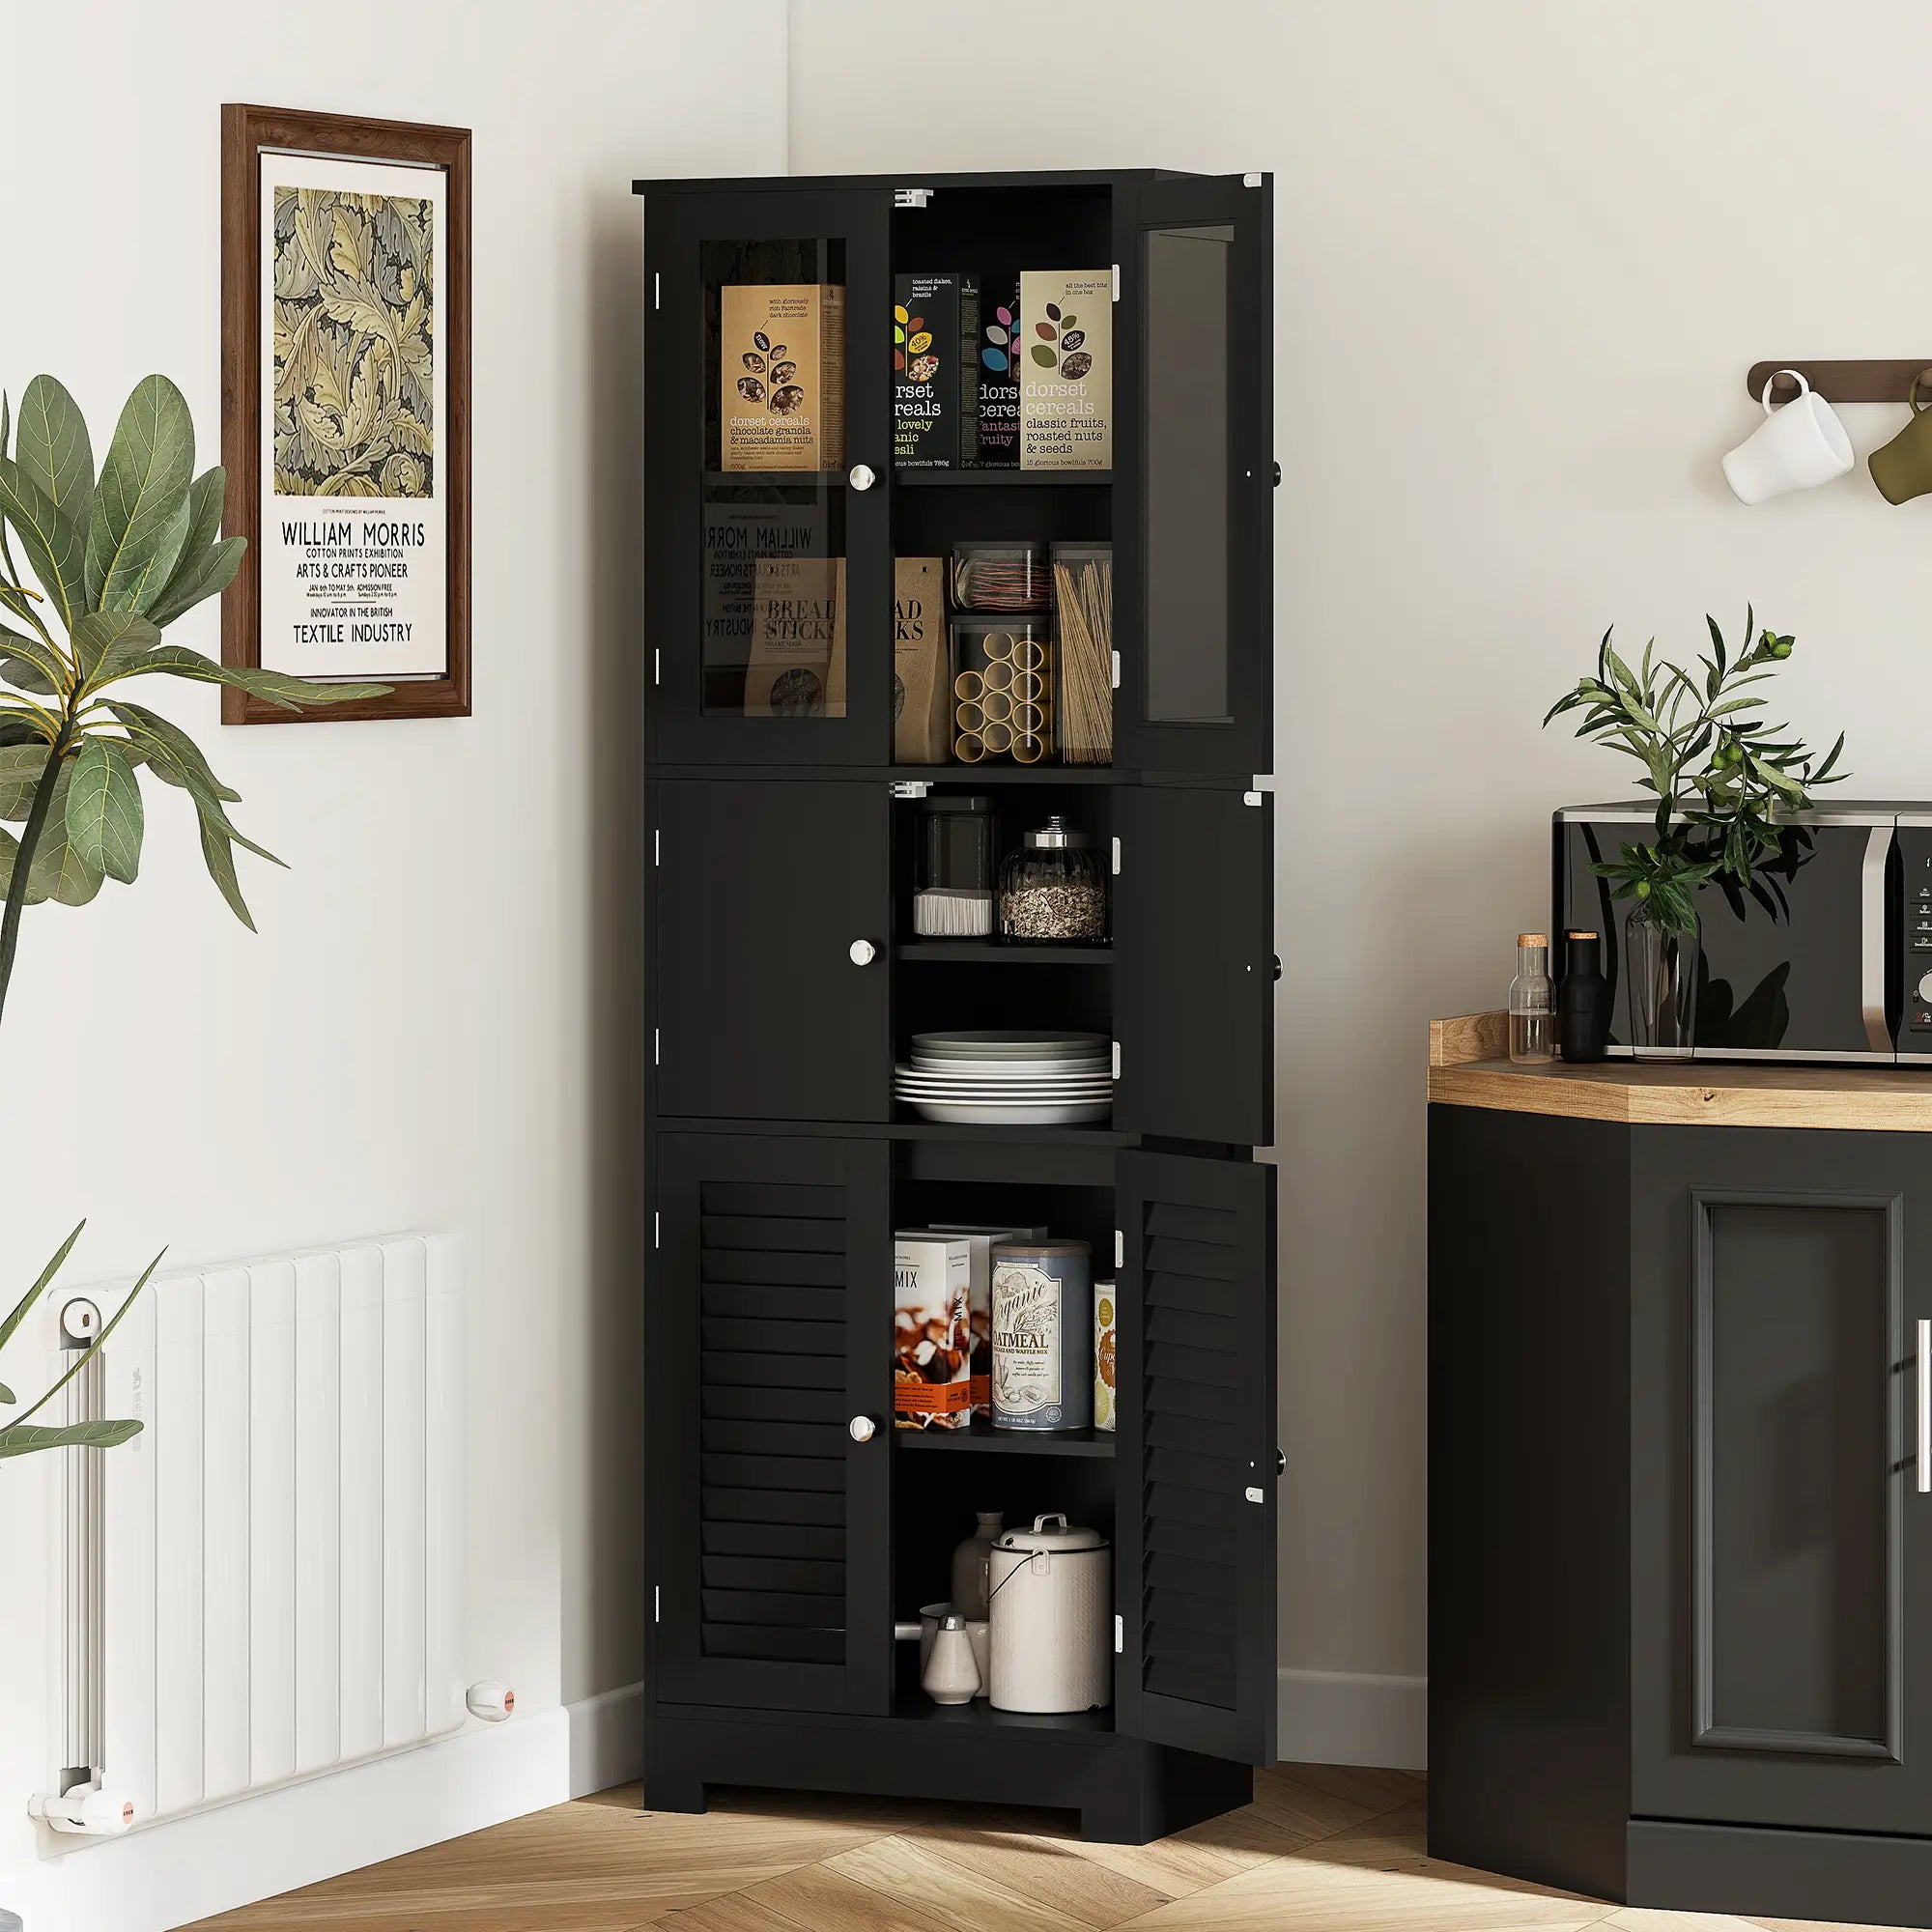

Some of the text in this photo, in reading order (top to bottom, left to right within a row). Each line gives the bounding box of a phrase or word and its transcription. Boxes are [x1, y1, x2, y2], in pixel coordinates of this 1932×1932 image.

[755, 334, 768, 350] new
[1026, 382, 1087, 397] dorset
[1026, 400, 1094, 415] cereals
[730, 416, 810, 426] dorset cereals
[897, 419, 933, 432] lovely
[1026, 418, 1107, 429] classic fruits,
[730, 427, 811, 436] chocolate granola
[1026, 431, 1103, 441] roasted nuts
[730, 436, 739, 444] &
[740, 436, 792, 444] macadamia
[1026, 443, 1073, 454] & seeds
[282, 522, 425, 547] WILLIAM MORRIS
[306, 548, 403, 558] COTTON PRINTS EXHIBITION
[296, 564, 408, 578] ARTS & CRAFTS PIONEER
[311, 608, 393, 617] INNOVATOR IN THE BRITISH
[768, 600, 837, 619] BREAD
[293, 624, 412, 643] TEXTILE INDUSTRY
[895, 1271, 917, 1288] MIX
[954, 1296, 963, 1322] MIX
